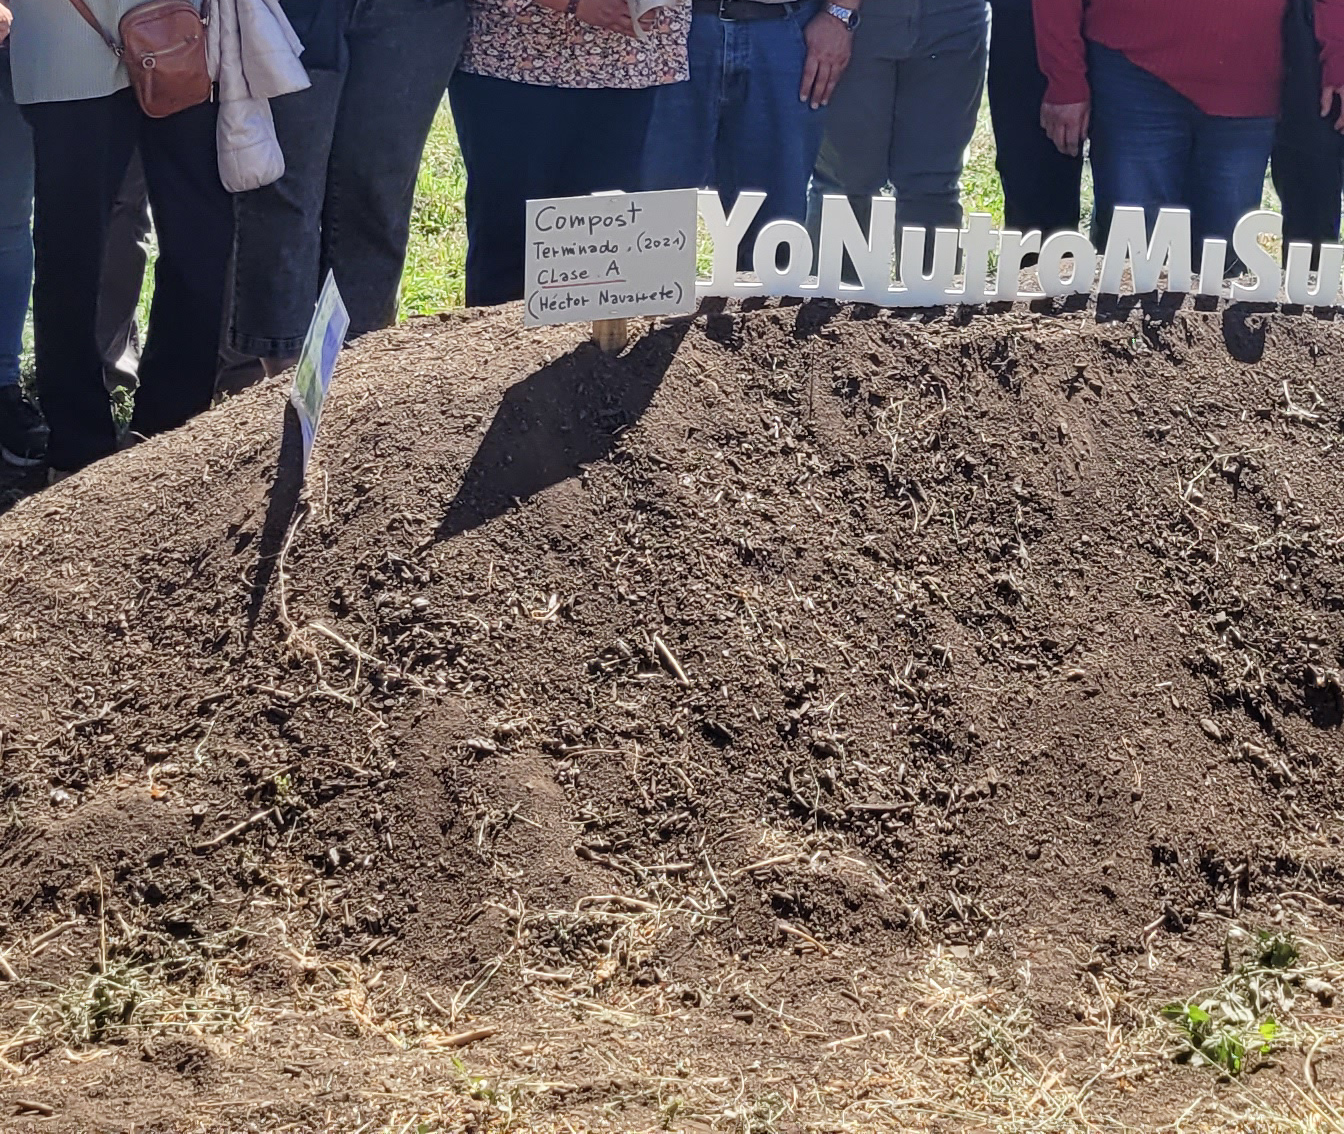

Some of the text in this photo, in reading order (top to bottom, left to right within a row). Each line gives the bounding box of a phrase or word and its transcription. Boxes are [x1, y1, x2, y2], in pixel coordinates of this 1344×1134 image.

[535, 201, 643, 236] Compost
[636, 230, 687, 253] (2021)
[605, 259, 621, 277] A
[598, 281, 684, 306] Navarrete)
